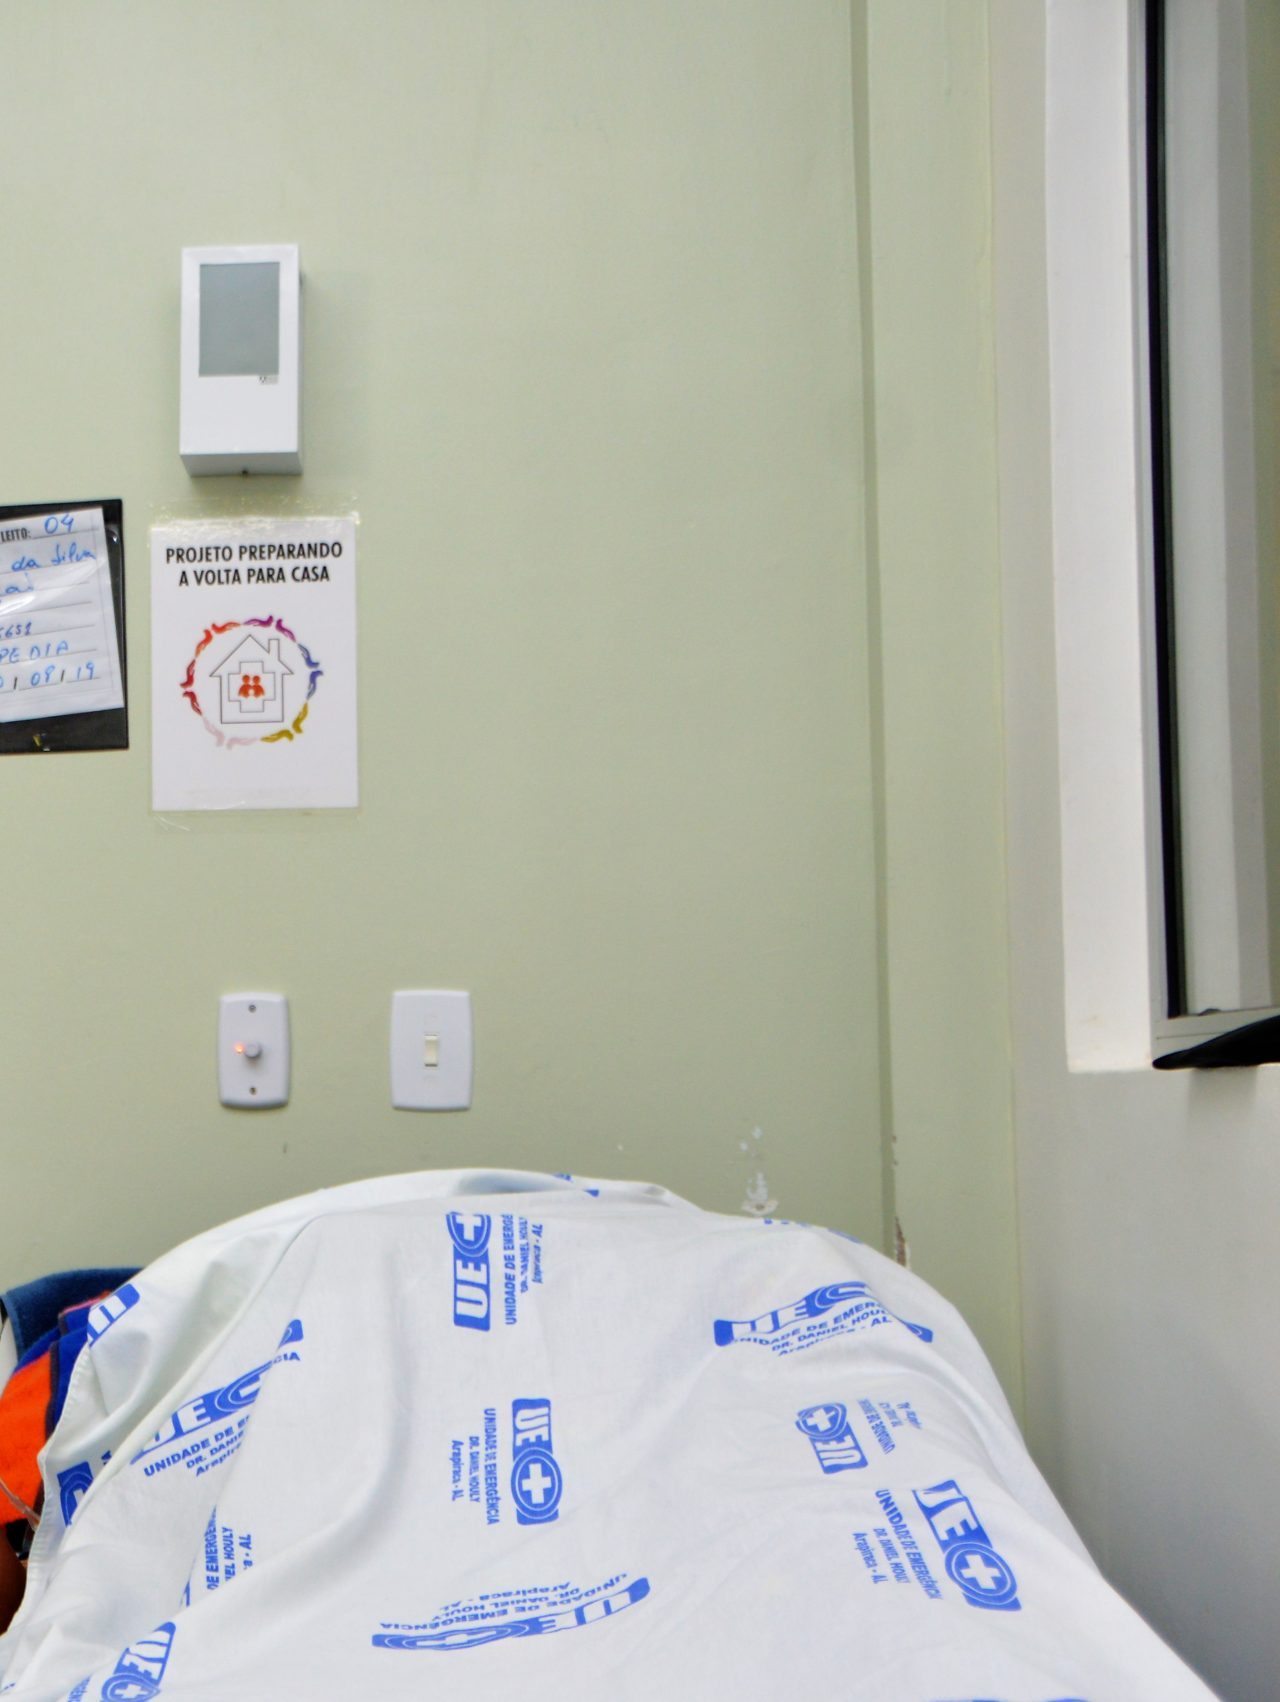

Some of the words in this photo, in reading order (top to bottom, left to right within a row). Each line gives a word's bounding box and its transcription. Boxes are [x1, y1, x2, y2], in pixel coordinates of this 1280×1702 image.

[0, 527, 31, 543] LEITO:
[44, 514, 74, 534] 04
[12, 556, 42, 571] da
[166, 546, 233, 564] PROJETO
[239, 542, 343, 561] PREPARANDO
[179, 570, 189, 586] A
[193, 568, 242, 586] VOLTA
[247, 567, 286, 584] PARA
[291, 566, 330, 582] CASA
[504, 1254, 516, 1270] DE
[505, 1272, 517, 1325] UNIDADE
[807, 1321, 828, 1333] DE
[484, 1408, 497, 1451] UNIDADE
[144, 1438, 210, 1476] UNIDADE
[214, 1426, 234, 1442] DE
[875, 1489, 913, 1540] UNIDADE
[222, 1527, 235, 1560] HOULY
